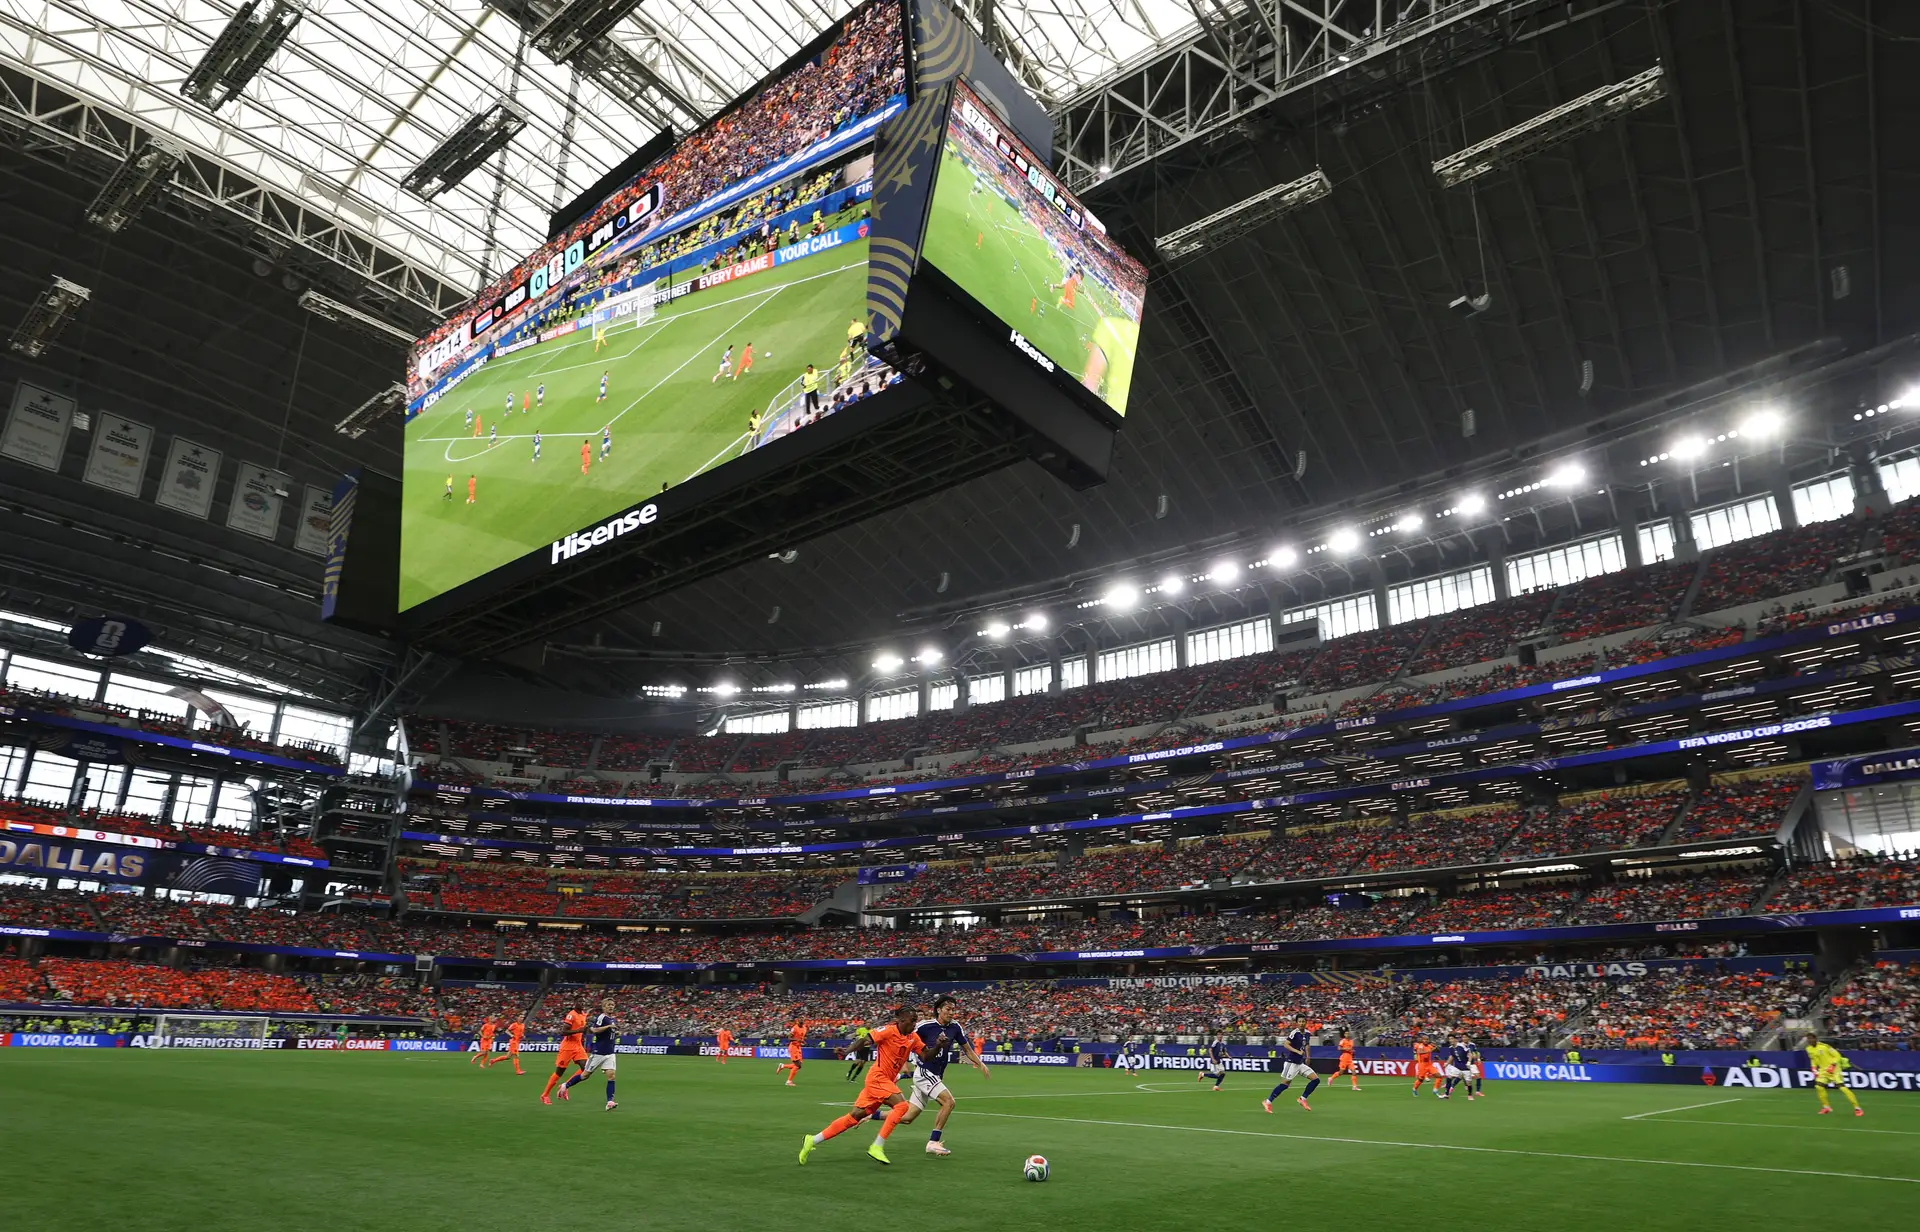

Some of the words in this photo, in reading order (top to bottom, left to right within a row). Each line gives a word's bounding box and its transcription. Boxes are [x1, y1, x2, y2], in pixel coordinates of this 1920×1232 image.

[856, 181, 873, 197] FIF
[588, 221, 614, 251] JPN
[779, 241, 810, 264] YOUR
[810, 232, 842, 251] CALL
[570, 248, 579, 265] 0
[699, 267, 733, 289] EVERY
[735, 255, 769, 278] GAME
[535, 274, 543, 291] 0
[427, 333, 462, 368] 17:14
[1010, 329, 1055, 373] Hisense
[551, 503, 658, 565] Hisense
[1828, 613, 1896, 635] DALLAS
[1336, 717, 1376, 730] DALLAS
[1679, 737, 1707, 749] FIFA
[1706, 730, 1754, 745] WORLD
[1754, 726, 1782, 738] CUP
[1782, 717, 1832, 733] 2026
[1427, 735, 1478, 748] DALLAS
[1129, 754, 1147, 763] FIFA
[1147, 750, 1176, 761] WORLD
[1176, 747, 1194, 757] CUP
[1193, 742, 1224, 754] 2026
[1862, 758, 1920, 775] DALLA
[1006, 769, 1036, 780] DALLAS
[438, 784, 472, 795] DALLAS
[1088, 786, 1125, 796] DALLAS
[1391, 779, 1430, 791] DALLAS
[584, 797, 611, 805] WORLD
[511, 816, 548, 824] DALLAS
[0, 840, 145, 877] DALLAS
[1900, 909, 1920, 918] FIF
[1655, 922, 1699, 932] DALLAS
[1251, 944, 1279, 952] DALLAS
[1178, 976, 1204, 988] CUP
[1204, 975, 1249, 987] 2026
[21, 1035, 60, 1046] YOUR
[62, 1036, 98, 1047] CALL
[174, 1037, 285, 1049] PREDICTSTREET
[346, 1040, 386, 1049] GAME
[396, 1041, 424, 1051] YOUR
[424, 1042, 448, 1051] CALL
[468, 1041, 497, 1052] AI
[613, 1045, 668, 1055] PREDICTSTREET
[727, 1047, 753, 1057] GAME
[759, 1048, 778, 1057] YOUR
[980, 1054, 996, 1062] FIFA
[996, 1054, 1023, 1064] WORLD
[1023, 1055, 1038, 1064] CUP
[1038, 1055, 1066, 1064] 2026
[1153, 1056, 1270, 1072] PREDICTTREET
[1494, 1063, 1542, 1079] YOUR
[1545, 1065, 1592, 1080] CALL
[1723, 1066, 1792, 1088] ADI
[1797, 1071, 1920, 1090] PEDICT
